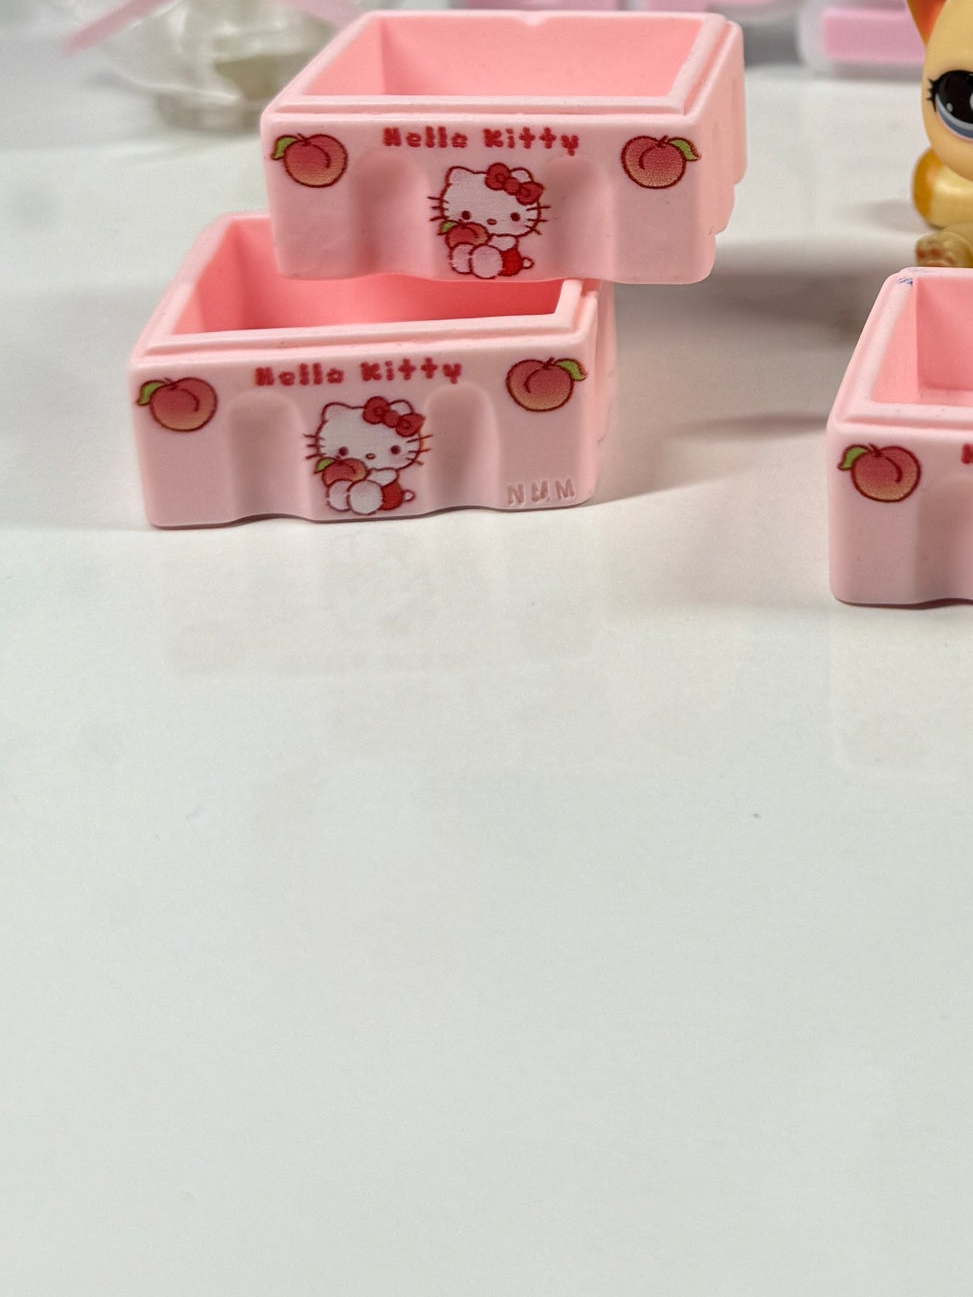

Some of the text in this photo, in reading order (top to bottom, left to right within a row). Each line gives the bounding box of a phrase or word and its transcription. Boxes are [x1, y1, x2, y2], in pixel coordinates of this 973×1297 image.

[380, 124, 581, 158] Hello Kitty
[252, 356, 464, 388] Hello Kitty
